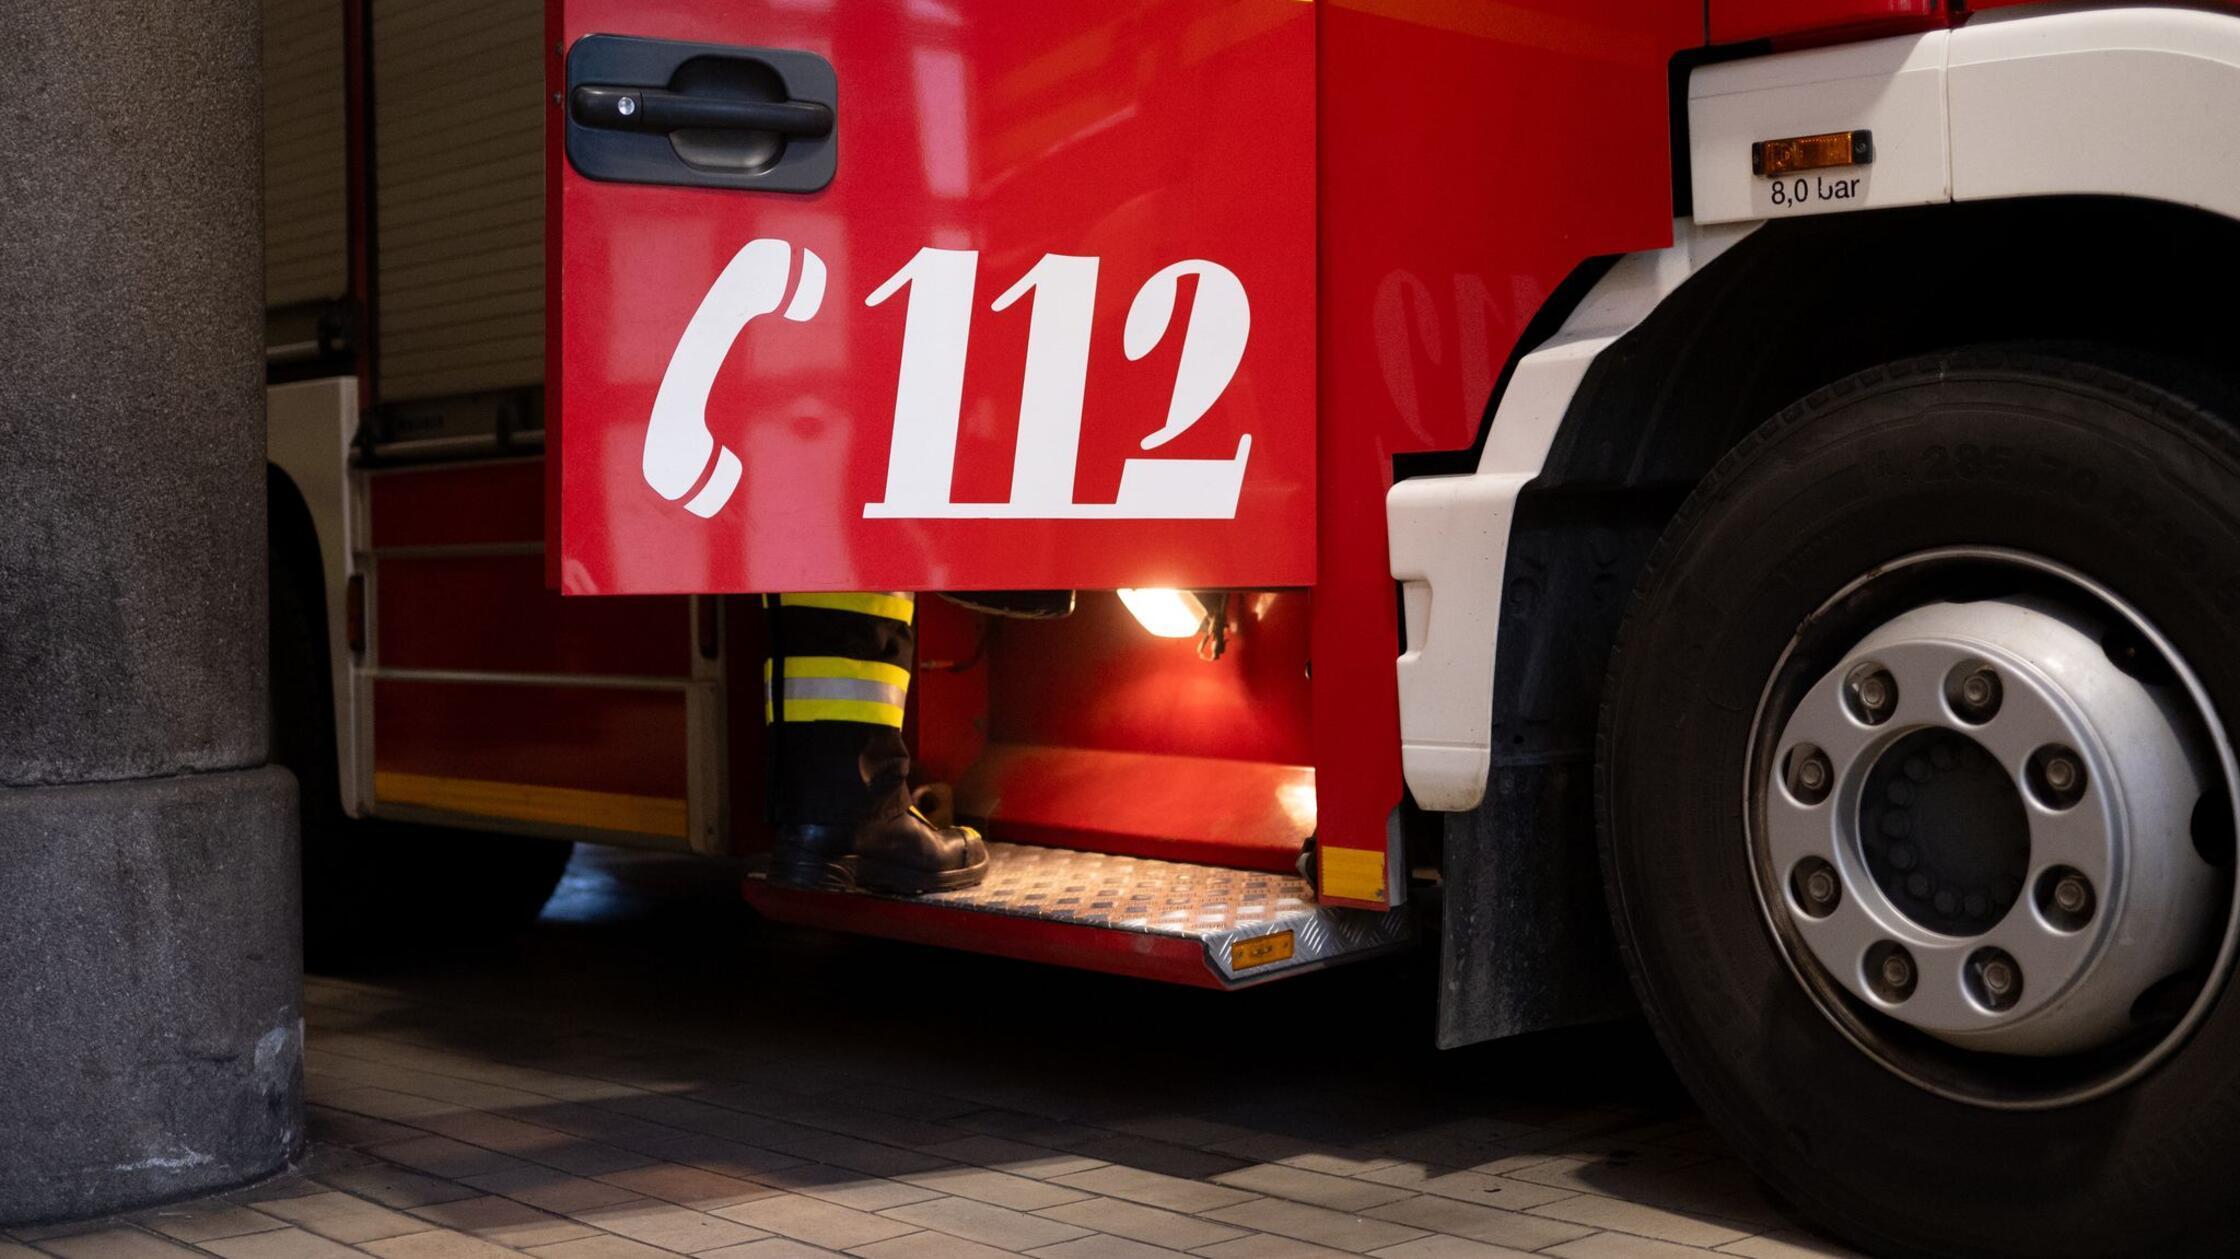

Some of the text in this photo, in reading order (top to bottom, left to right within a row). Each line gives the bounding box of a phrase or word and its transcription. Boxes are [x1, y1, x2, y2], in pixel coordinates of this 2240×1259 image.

[1770, 177, 1861, 208] 8,0 bar
[862, 246, 1252, 519] 112
